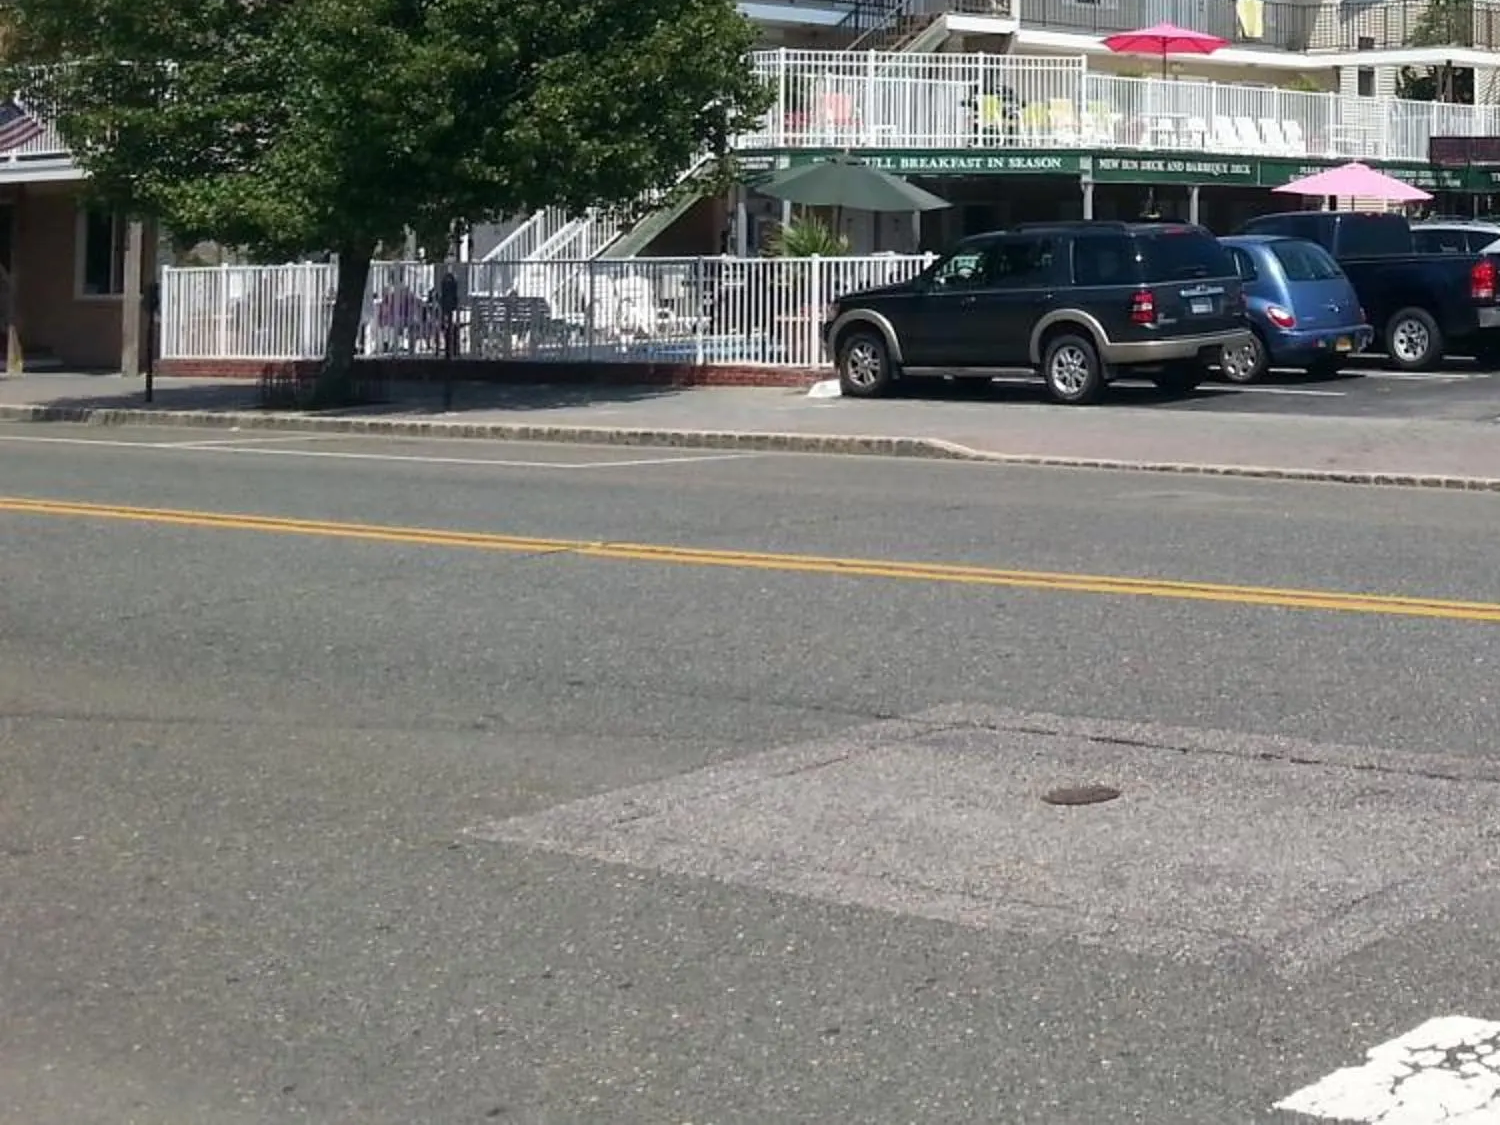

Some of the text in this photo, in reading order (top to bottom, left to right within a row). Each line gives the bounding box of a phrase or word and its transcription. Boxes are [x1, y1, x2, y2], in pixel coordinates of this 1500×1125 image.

[900, 157, 983, 168] BREAKFAST
[987, 157, 1003, 168] IN
[1007, 156, 1062, 168] SEASON
[1099, 159, 1120, 169] NEW
[1166, 161, 1184, 171] AND
